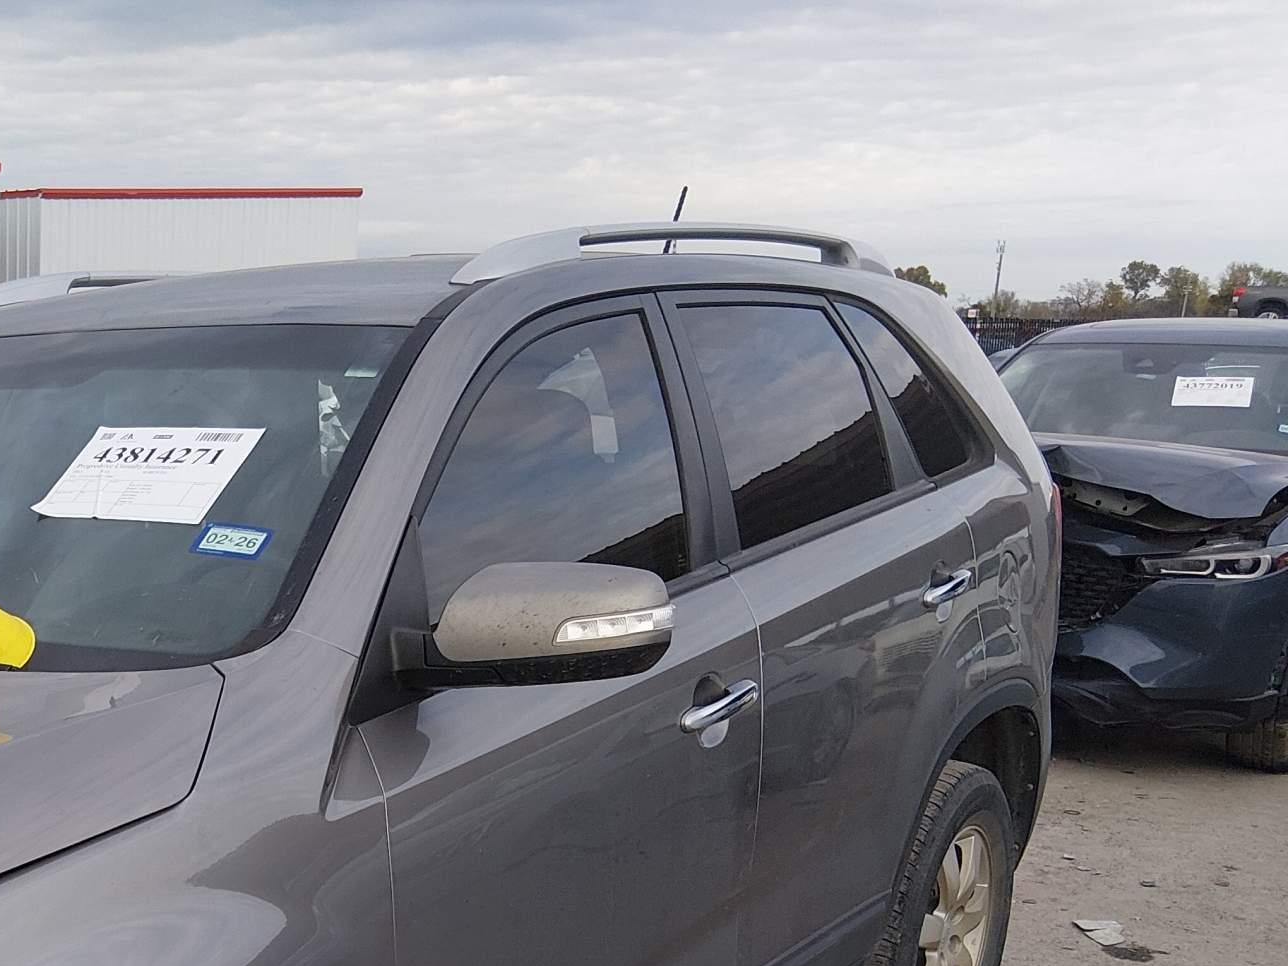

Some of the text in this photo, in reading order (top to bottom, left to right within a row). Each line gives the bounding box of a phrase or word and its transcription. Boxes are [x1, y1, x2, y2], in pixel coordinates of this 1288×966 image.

[93, 446, 225, 465] 43814271
[206, 532, 258, 549] 02 26
